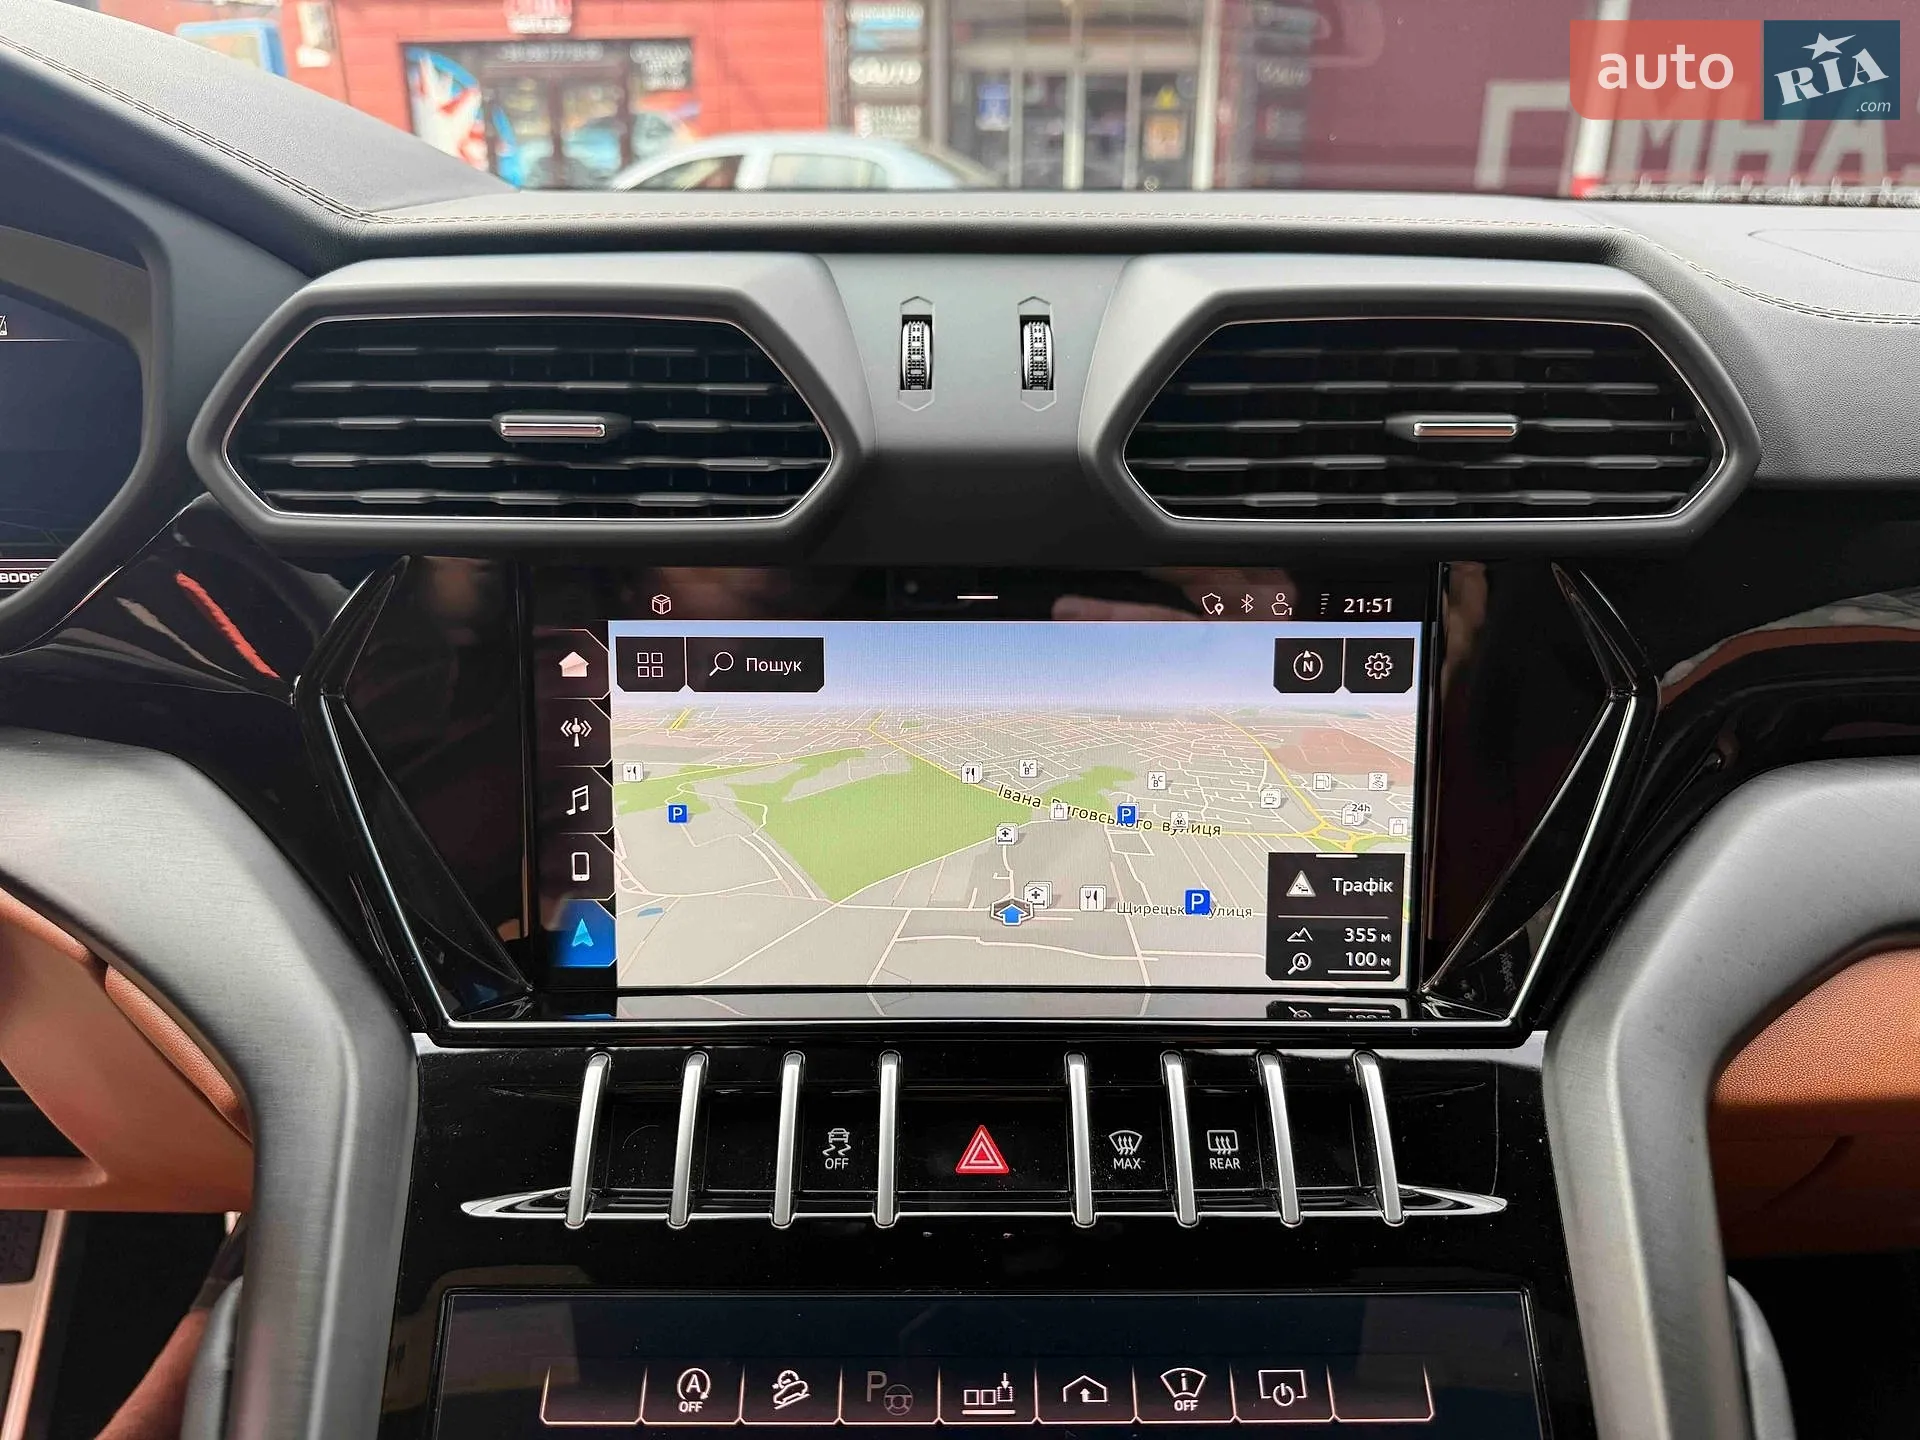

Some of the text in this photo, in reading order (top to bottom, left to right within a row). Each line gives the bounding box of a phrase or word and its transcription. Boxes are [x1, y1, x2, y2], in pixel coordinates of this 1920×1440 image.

[1343, 597, 1393, 613] 21:51
[746, 657, 802, 676] Пошук
[1303, 660, 1314, 672] N
[998, 784, 1041, 808] Івана
[1351, 803, 1371, 813] 24h
[1332, 877, 1394, 896] Трафік
[1344, 927, 1378, 943] 355
[1345, 952, 1378, 967] 100
[824, 1158, 849, 1170] OFF
[1113, 1157, 1142, 1170] MAX
[1209, 1157, 1241, 1170] REAR
[678, 1401, 703, 1413] OFF
[1173, 1400, 1199, 1412] OFF
